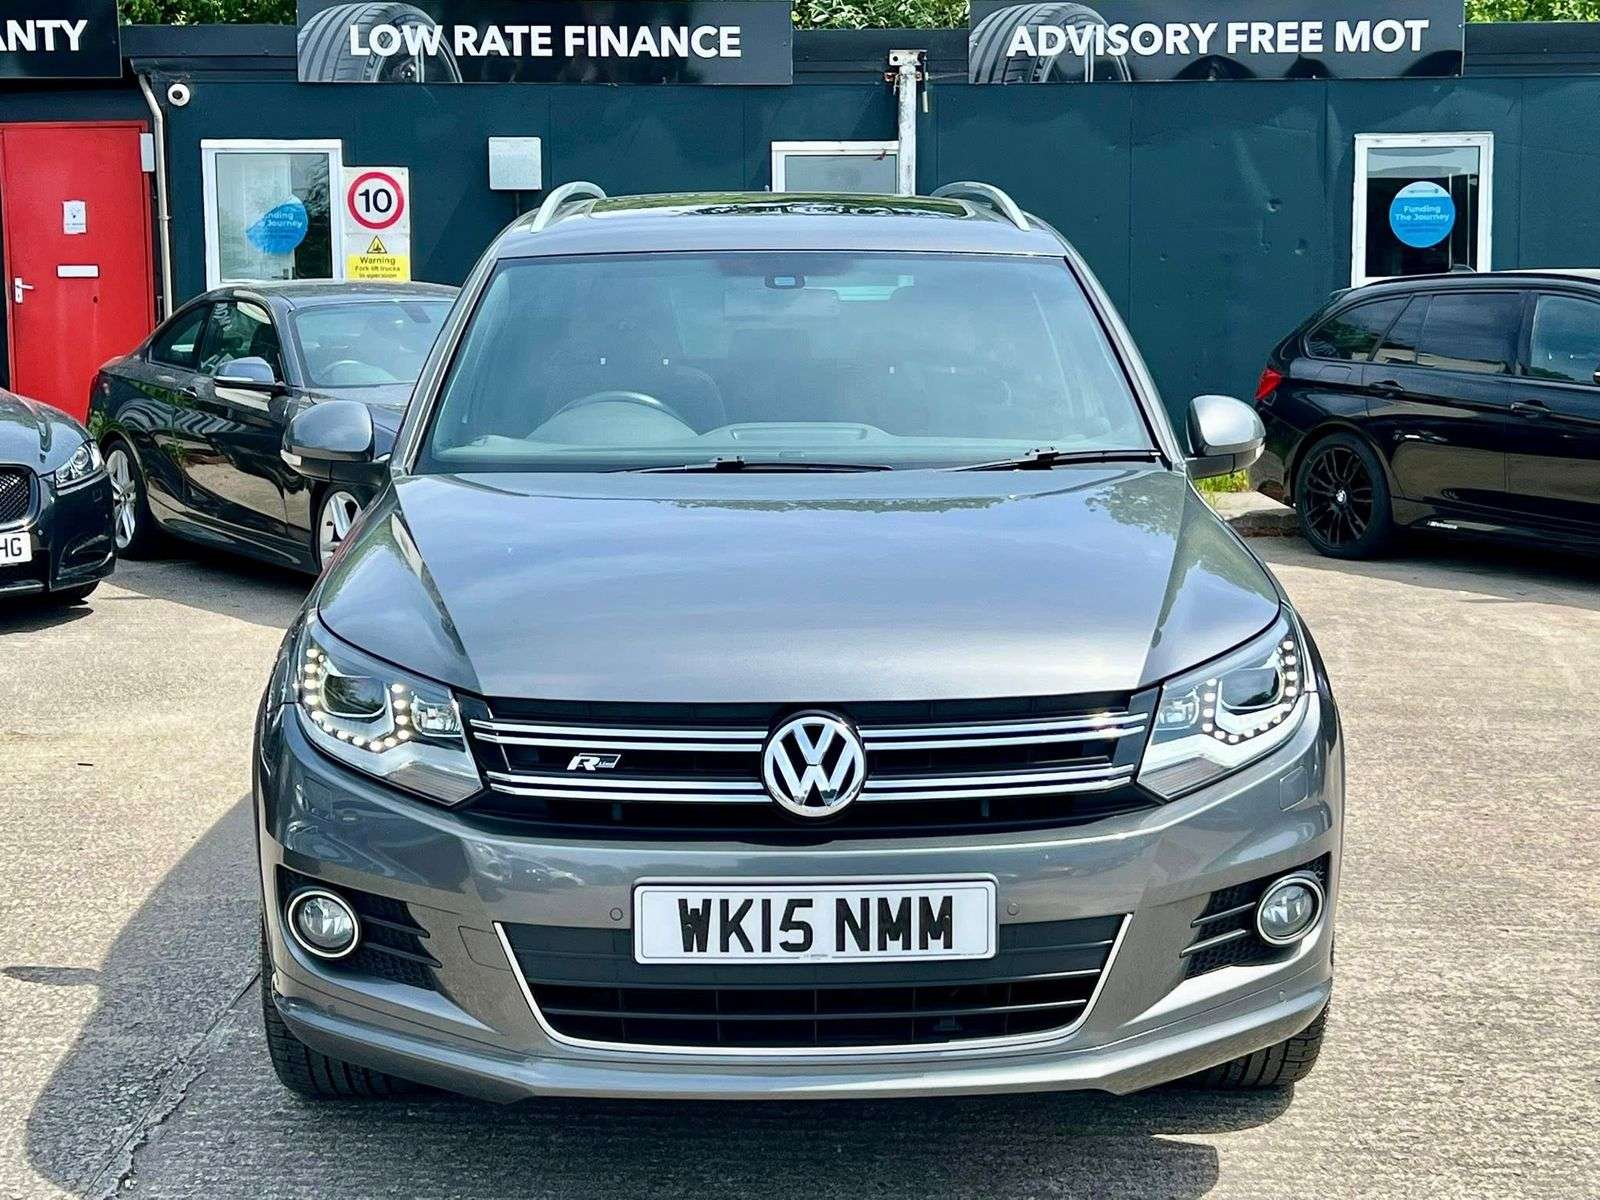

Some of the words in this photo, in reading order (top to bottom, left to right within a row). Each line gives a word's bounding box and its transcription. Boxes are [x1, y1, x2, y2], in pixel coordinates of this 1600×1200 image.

[350, 24, 443, 57] LOW
[454, 25, 553, 57] RATE
[564, 25, 742, 58] FINANCE
[1006, 22, 1219, 57] ADVISORY
[1227, 21, 1324, 54] FREE
[1335, 19, 1430, 53] MOT
[358, 188, 393, 213] 10
[1404, 205, 1441, 213] Funding
[1413, 214, 1450, 222] Journey
[359, 256, 396, 265] Warning
[678, 898, 814, 953] WK15
[835, 895, 953, 952] NMM
